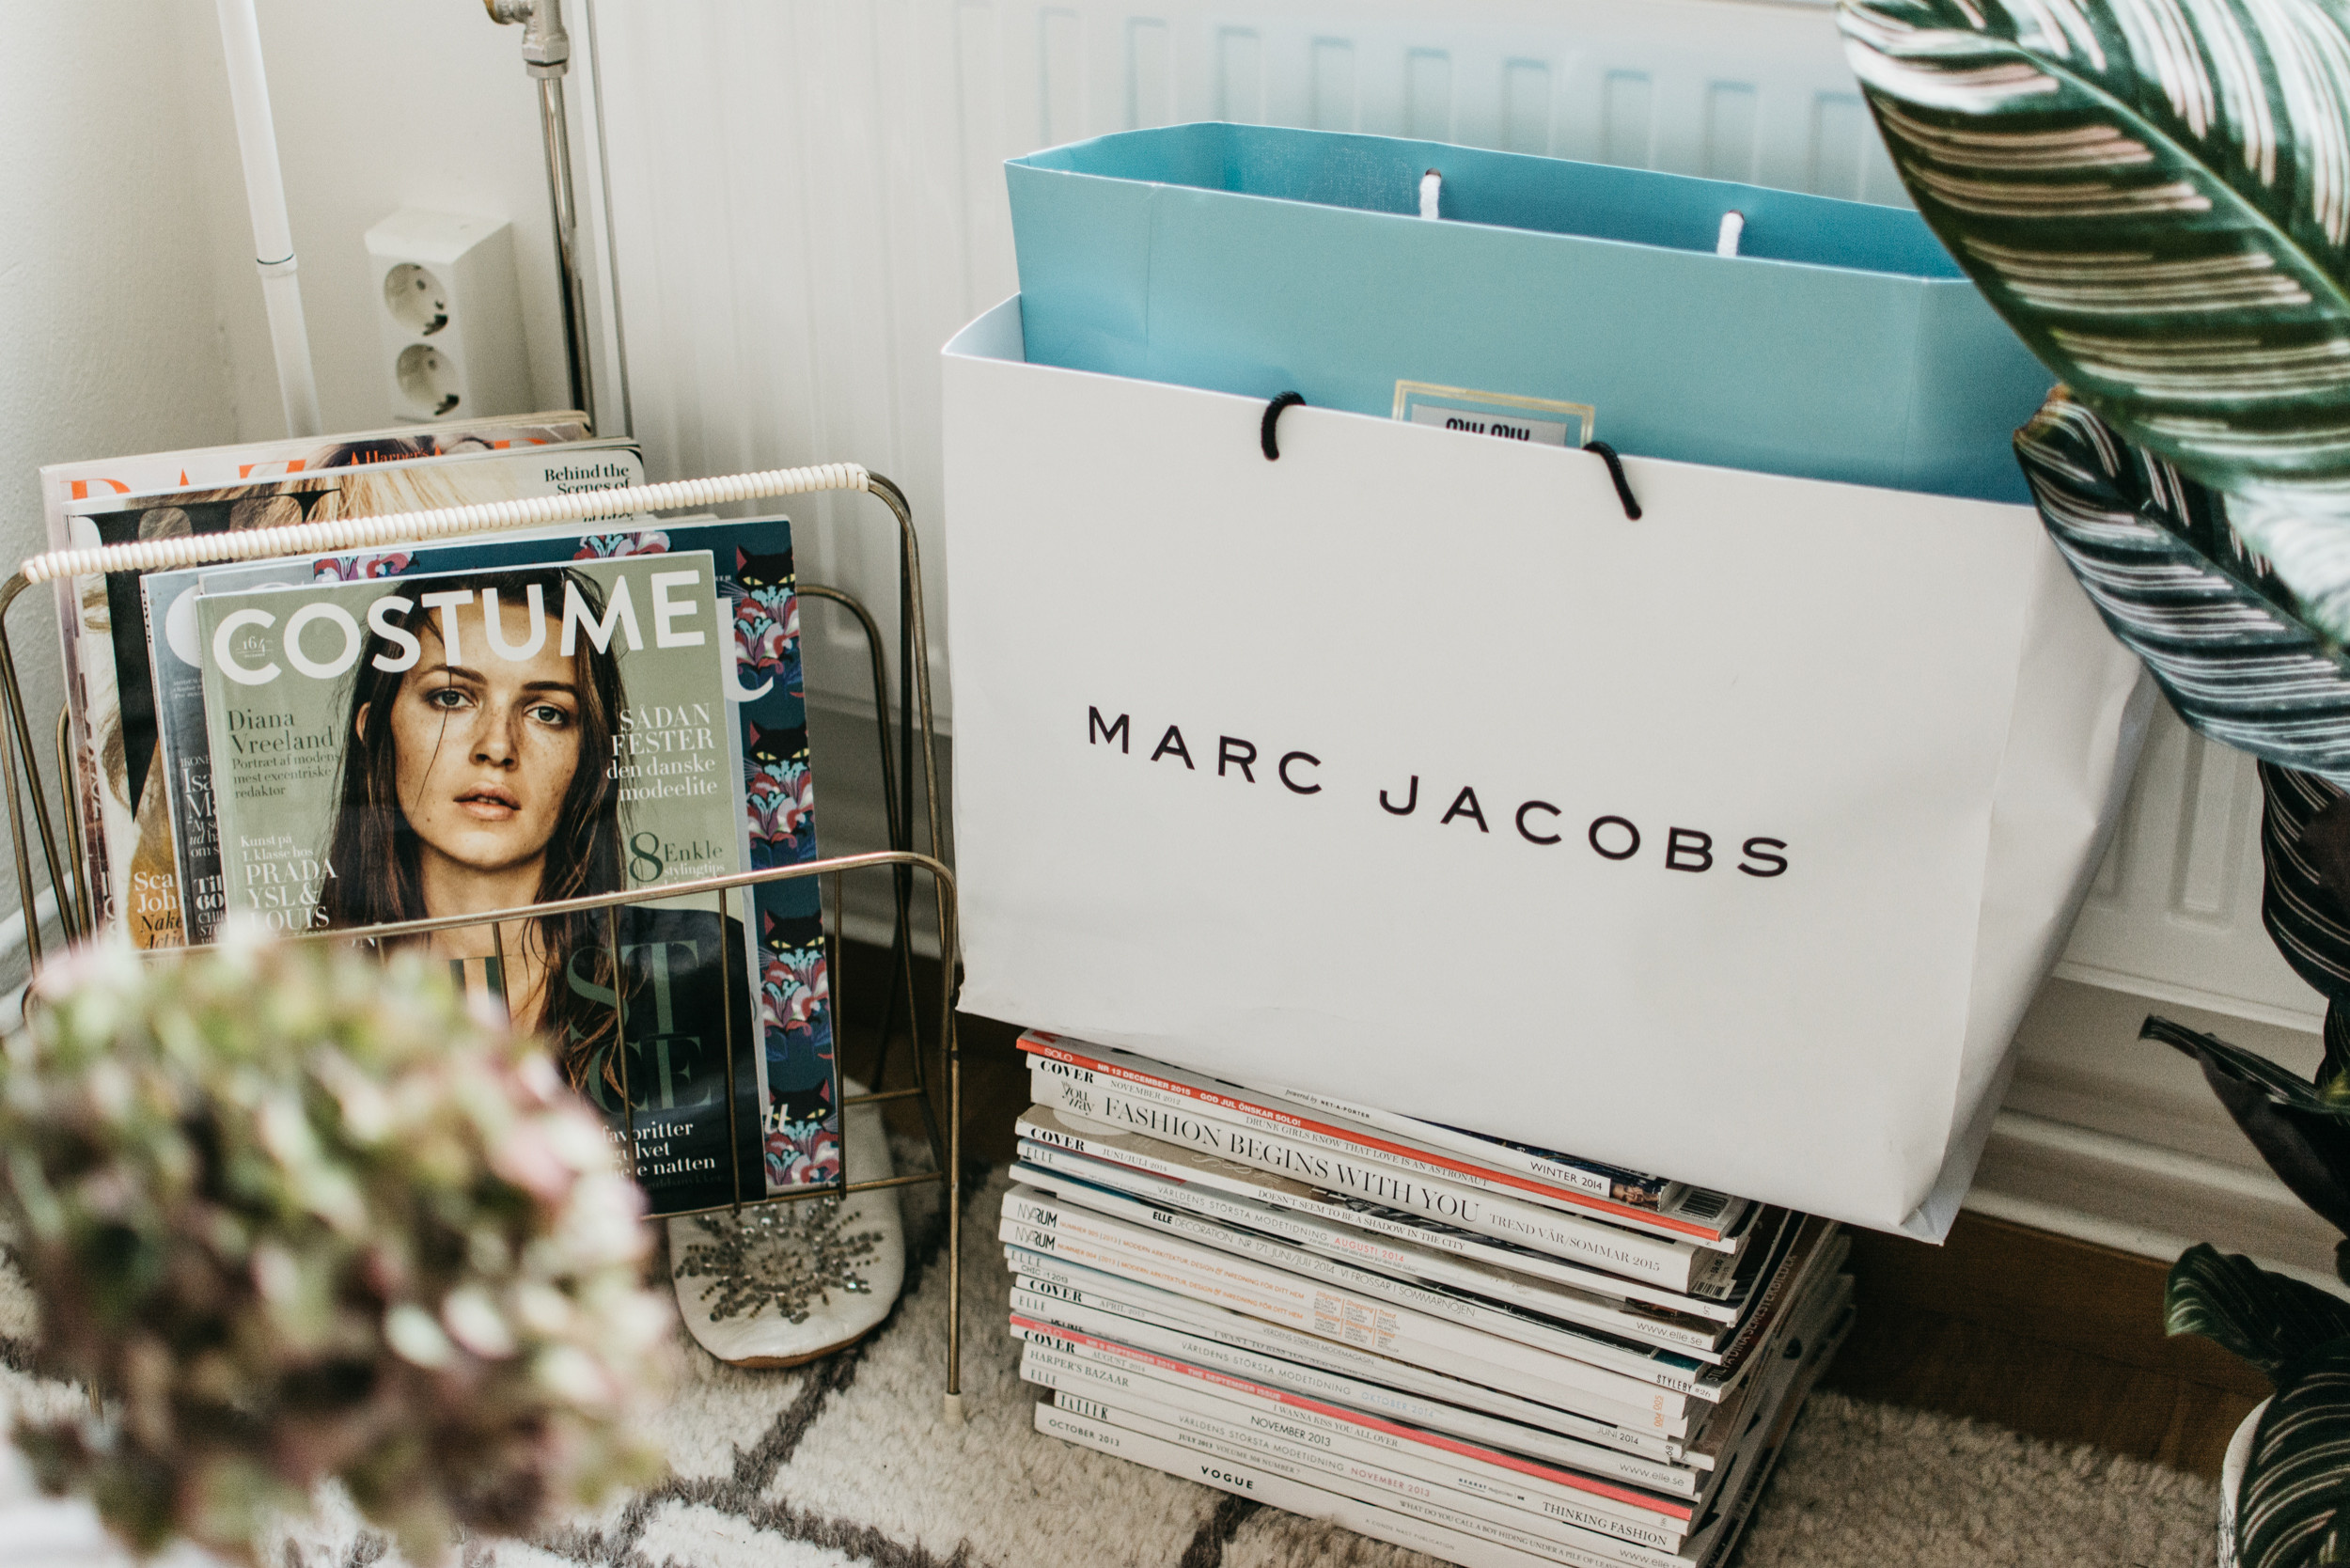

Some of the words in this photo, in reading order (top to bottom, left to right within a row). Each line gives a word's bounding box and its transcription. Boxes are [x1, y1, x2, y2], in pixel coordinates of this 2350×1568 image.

[544, 464, 600, 482] Behind
[603, 463, 629, 478] the
[212, 570, 705, 685] COSTUME
[243, 635, 265, 652] 164
[227, 709, 294, 730] Diana
[620, 702, 711, 731] SÅDAN
[231, 725, 333, 754] Vreeland
[612, 728, 715, 756] FESTER
[232, 757, 277, 769] Portræt
[280, 753, 291, 766] af
[294, 750, 340, 764] modens
[606, 758, 642, 780] den
[646, 754, 716, 776] danske
[234, 772, 262, 784] mest
[264, 765, 332, 781] excentriske
[619, 775, 717, 801] modeelite
[1089, 705, 1323, 795] MARC
[1379, 774, 1790, 879] JACOBS
[241, 835, 277, 848] Kunst
[278, 833, 292, 849] på
[254, 848, 290, 861] klasse
[292, 845, 313, 857] hos
[246, 857, 338, 886] PRADA
[629, 832, 663, 883] 8
[664, 839, 723, 862] Enkle
[664, 861, 726, 881] stylingtips
[248, 886, 296, 909] YSL
[300, 882, 320, 905] &
[1041, 1060, 1093, 1083] COVER
[1111, 1081, 1159, 1099] NOVEMBER
[1163, 1094, 1181, 1105] 2012
[1044, 1047, 1072, 1061] SOLO
[1124, 1072, 1167, 1089] DECEMBER
[1171, 1084, 1190, 1095] 2015
[1200, 1092, 1218, 1103] GOD
[1221, 1097, 1235, 1108] JUL
[1239, 1103, 1272, 1118] ÖNSKAR
[1276, 1114, 1302, 1125] SOLO!
[1285, 1089, 1310, 1102] powered
[1321, 1101, 1370, 1118] NET-A-PORTER
[1026, 1147, 1053, 1163] ELLE
[1031, 1128, 1085, 1151] COVER
[1102, 1148, 1147, 1166] JUNI/JULI
[1150, 1161, 1167, 1171] 2014
[1104, 1097, 1222, 1147] FASHION
[1230, 1134, 1330, 1179] BEGINS
[1333, 1164, 1413, 1203] WITH
[1418, 1189, 1478, 1222] YOU
[1246, 1117, 1278, 1131] DRUNK
[1282, 1126, 1308, 1139] GIRLS
[1312, 1134, 1339, 1147] KNOW
[1344, 1142, 1370, 1155] THAT
[1373, 1150, 1400, 1163] LOVE
[1429, 1165, 1487, 1186] ASTRONAUT
[653, 1157, 715, 1176] natten
[1529, 1161, 1577, 1184] WINTER
[1581, 1177, 1603, 1190] 2014
[1158, 1185, 1205, 1206] VÄRLDENS
[1209, 1200, 1250, 1218] STÖRSTA
[1255, 1214, 1326, 1241] MODETIDNING
[1335, 1237, 1377, 1255] AUGUSTI
[1381, 1250, 1404, 1262] 2014
[1298, 1200, 1324, 1213] SEEM
[1365, 1217, 1404, 1234] SHADOW
[1420, 1232, 1439, 1243] THE
[1441, 1238, 1465, 1249] CITY
[1152, 1212, 1172, 1224] ELLE
[1175, 1218, 1231, 1242] DECORATION
[1237, 1237, 1252, 1248] NR
[1271, 1247, 1311, 1267] JUNI/JULI
[1313, 1260, 1335, 1273] 2014
[1352, 1272, 1390, 1290] FROSSAR
[1488, 1214, 1534, 1234] TREND
[1537, 1226, 1630, 1262] VÅR/SOMMAR
[1633, 1257, 1660, 1271] 2015
[1010, 1250, 1040, 1266] ELLE
[1102, 1232, 1119, 1244] 2013
[1289, 1289, 1304, 1299] HEM
[1021, 1264, 1041, 1275] CHIC
[1050, 1273, 1068, 1284] 2013
[1100, 1255, 1116, 1265] 2013
[1288, 1309, 1302, 1319] HEM
[1018, 1295, 1046, 1311] ELLE
[1029, 1280, 1082, 1302] COVER
[1099, 1300, 1124, 1312] APRIL
[1035, 1324, 1061, 1337] SOLO
[1636, 1318, 1702, 1346] www.elle.se
[1025, 1330, 1074, 1353] COVER
[1091, 1351, 1126, 1366] AUGUST
[1030, 1349, 1083, 1373] HARPER'S
[1084, 1366, 1128, 1388] BAZAAR
[1030, 1369, 1058, 1386] ELLE
[1182, 1340, 1229, 1361] VÄRLDENS
[1233, 1355, 1274, 1373] STÖRSTA
[1279, 1368, 1350, 1395] MODETIDNING
[1362, 1391, 1406, 1410] OKTOBER
[1411, 1405, 1434, 1418] 2014
[1656, 1374, 1691, 1392] STYLEBY
[1048, 1419, 1095, 1439] OCTOBER
[1098, 1434, 1120, 1447] 2013
[1178, 1433, 1197, 1443] JULY
[1250, 1415, 1305, 1439] NOVEMBER
[1308, 1433, 1331, 1447] 2013
[1278, 1406, 1311, 1421] WANNA
[1313, 1417, 1333, 1427] KISS
[1334, 1422, 1353, 1434] YOU
[1355, 1429, 1372, 1439] ALL
[1373, 1435, 1399, 1447] OVER
[1596, 1427, 1618, 1438] JUNI
[1619, 1433, 1638, 1444] 2014
[1178, 1413, 1225, 1435] VÄRLDENS
[1229, 1428, 1268, 1449] STÖRSTA
[1274, 1444, 1343, 1471] MODETIDNING
[1351, 1466, 1403, 1489] NOVEMBER
[1407, 1484, 1431, 1497] 2013
[1199, 1466, 1254, 1489] VOGUE
[1619, 1462, 1684, 1486] www.elle.se
[1399, 1500, 1423, 1513] WHAT
[1437, 1512, 1455, 1522] YOU
[1454, 1517, 1474, 1528] CALL
[1482, 1525, 1497, 1535] BOY
[1499, 1530, 1528, 1544] HIDING
[1530, 1540, 1557, 1553] UNDER
[1566, 1550, 1582, 1561] PILE
[1542, 1500, 1606, 1529] THINKING
[1610, 1521, 1667, 1545] FASHION
